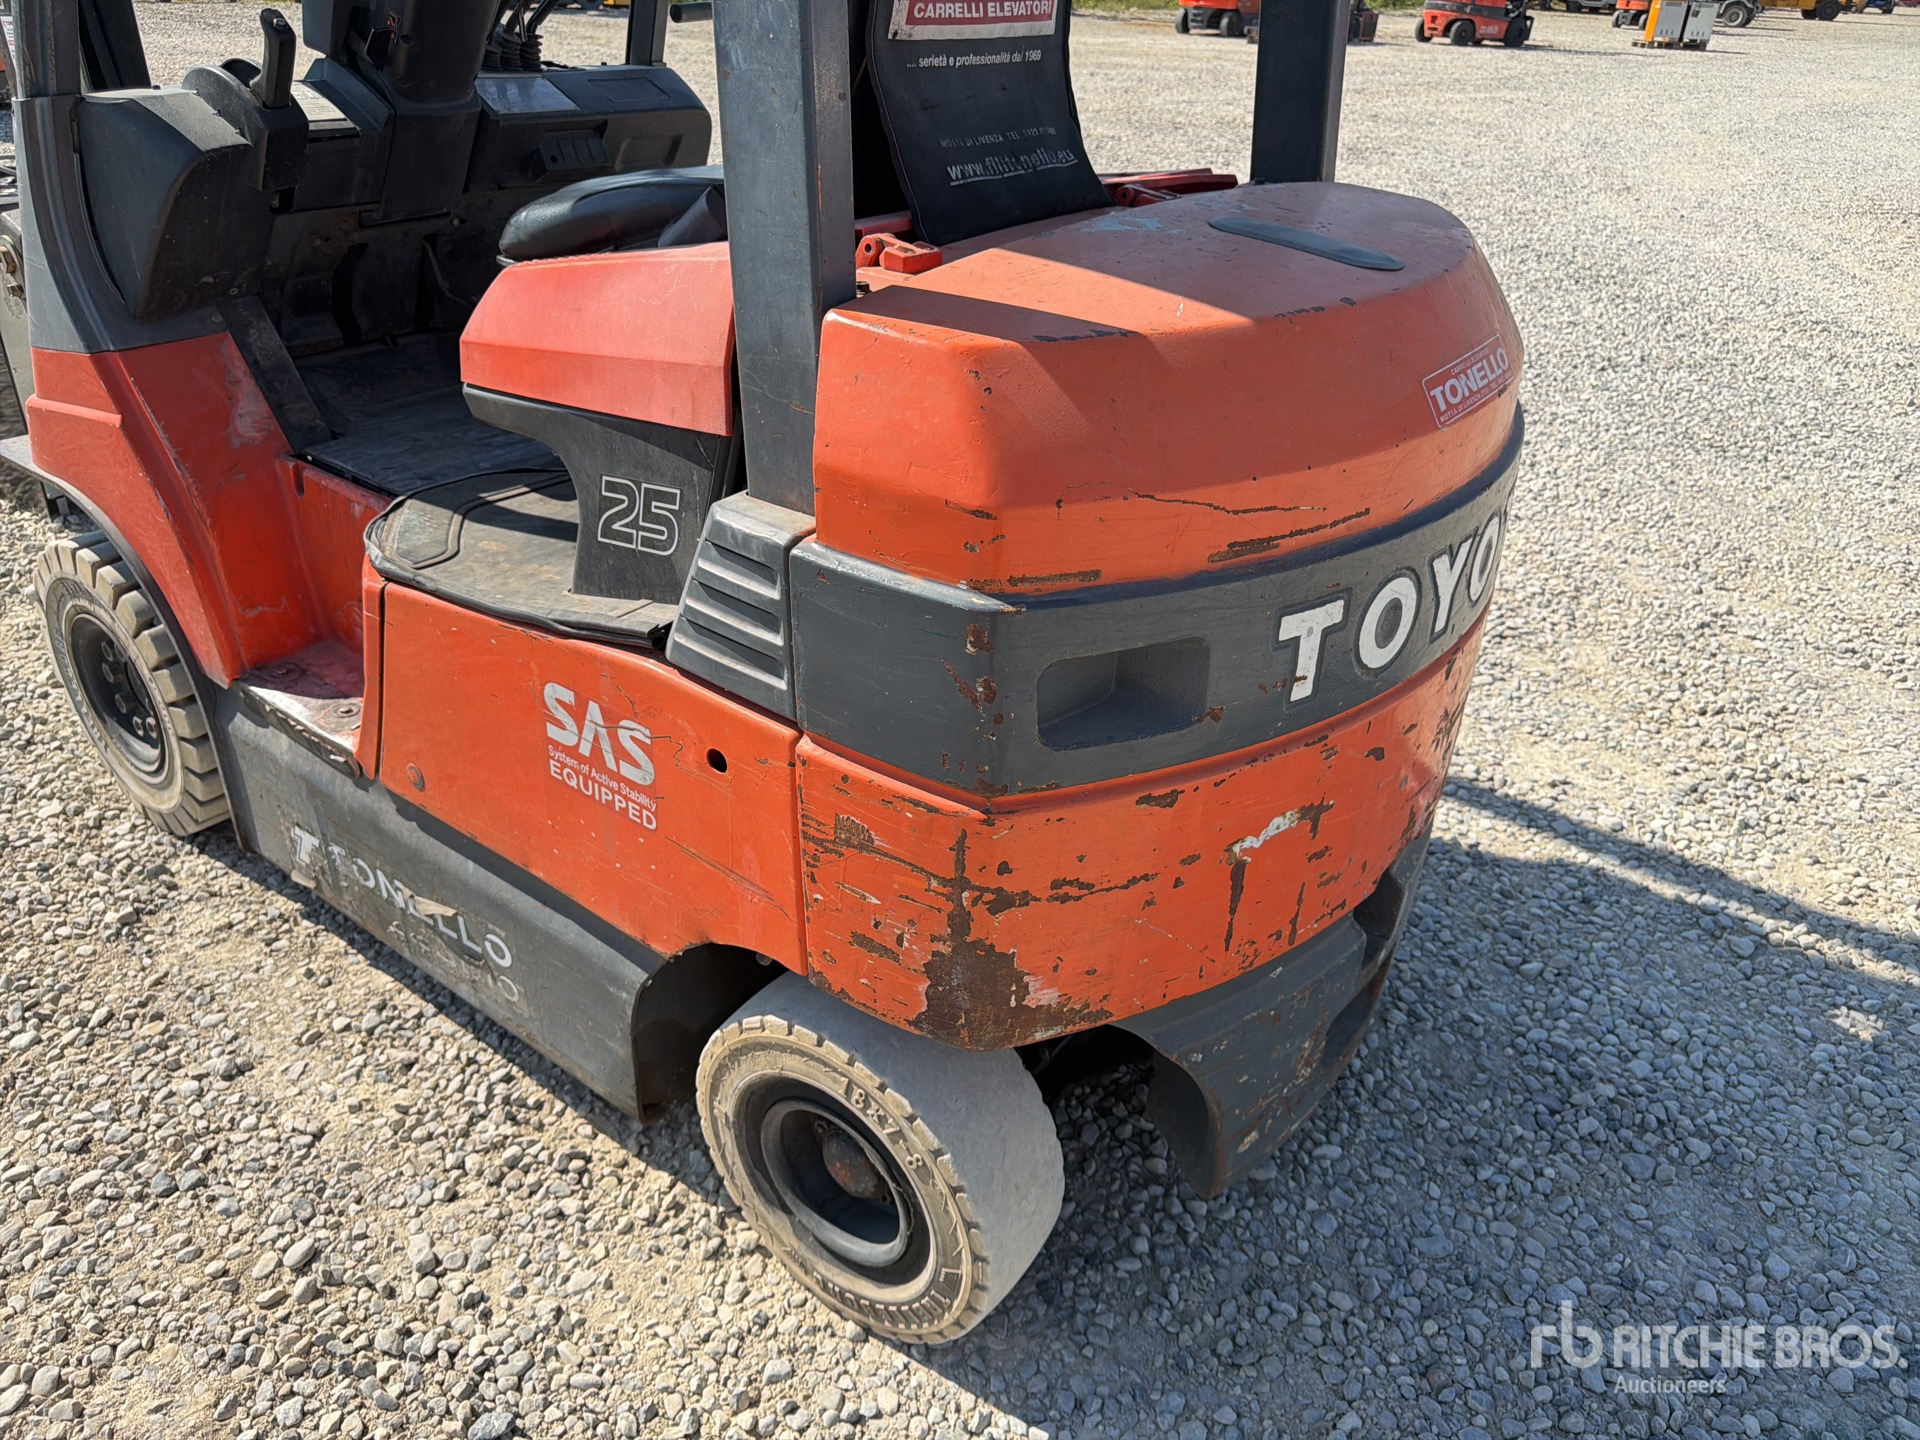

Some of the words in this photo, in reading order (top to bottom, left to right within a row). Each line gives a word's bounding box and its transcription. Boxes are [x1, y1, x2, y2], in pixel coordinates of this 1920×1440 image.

[913, 2, 984, 19] CARRELLI
[987, 0, 1052, 17] ELEVATORI
[918, 54, 947, 68] serietà
[949, 57, 954, 67] e
[955, 51, 1011, 69] professionalità
[940, 138, 964, 148] MOT
[1429, 347, 1509, 413] TONELLO
[597, 475, 681, 556] 25
[543, 682, 655, 786] SAS
[548, 744, 580, 771] System
[580, 763, 590, 775] of
[590, 767, 619, 791] Active
[620, 782, 657, 812] Stability
[549, 758, 657, 830] EQUIPPED
